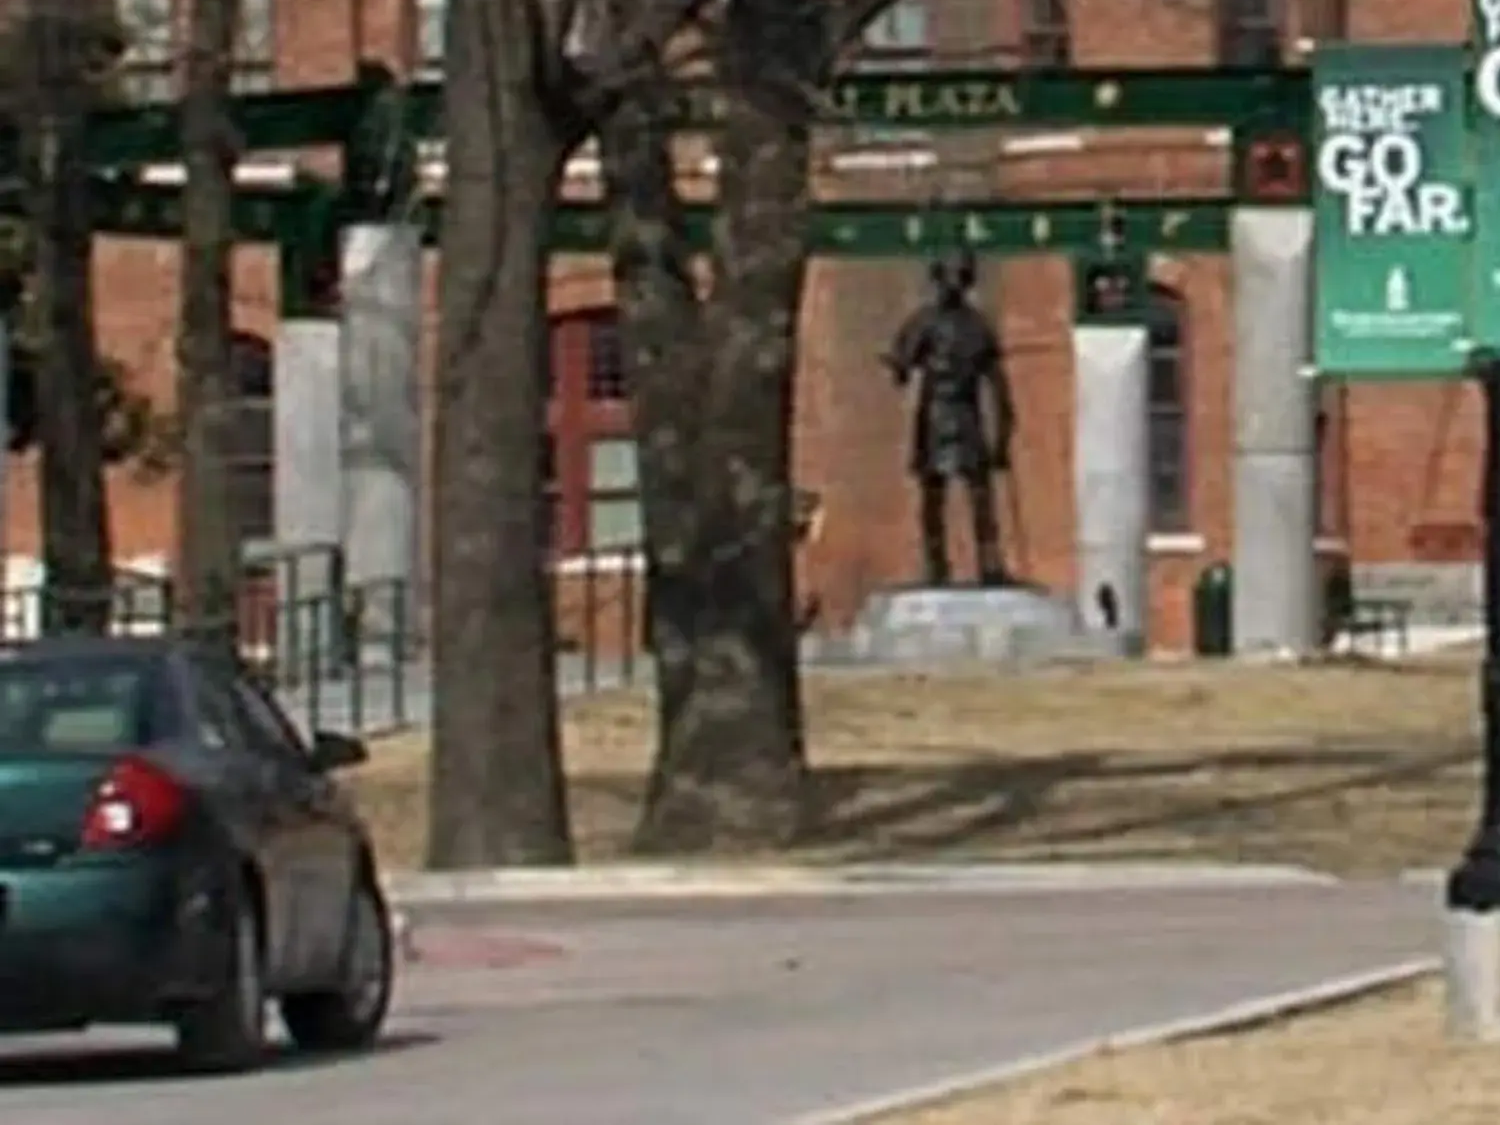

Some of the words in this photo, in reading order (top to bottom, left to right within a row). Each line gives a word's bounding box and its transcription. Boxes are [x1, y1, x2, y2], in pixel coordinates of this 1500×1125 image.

[1320, 84, 1443, 113] GATHER
[1319, 134, 1421, 195] GO
[1349, 183, 1470, 235] FAR.
